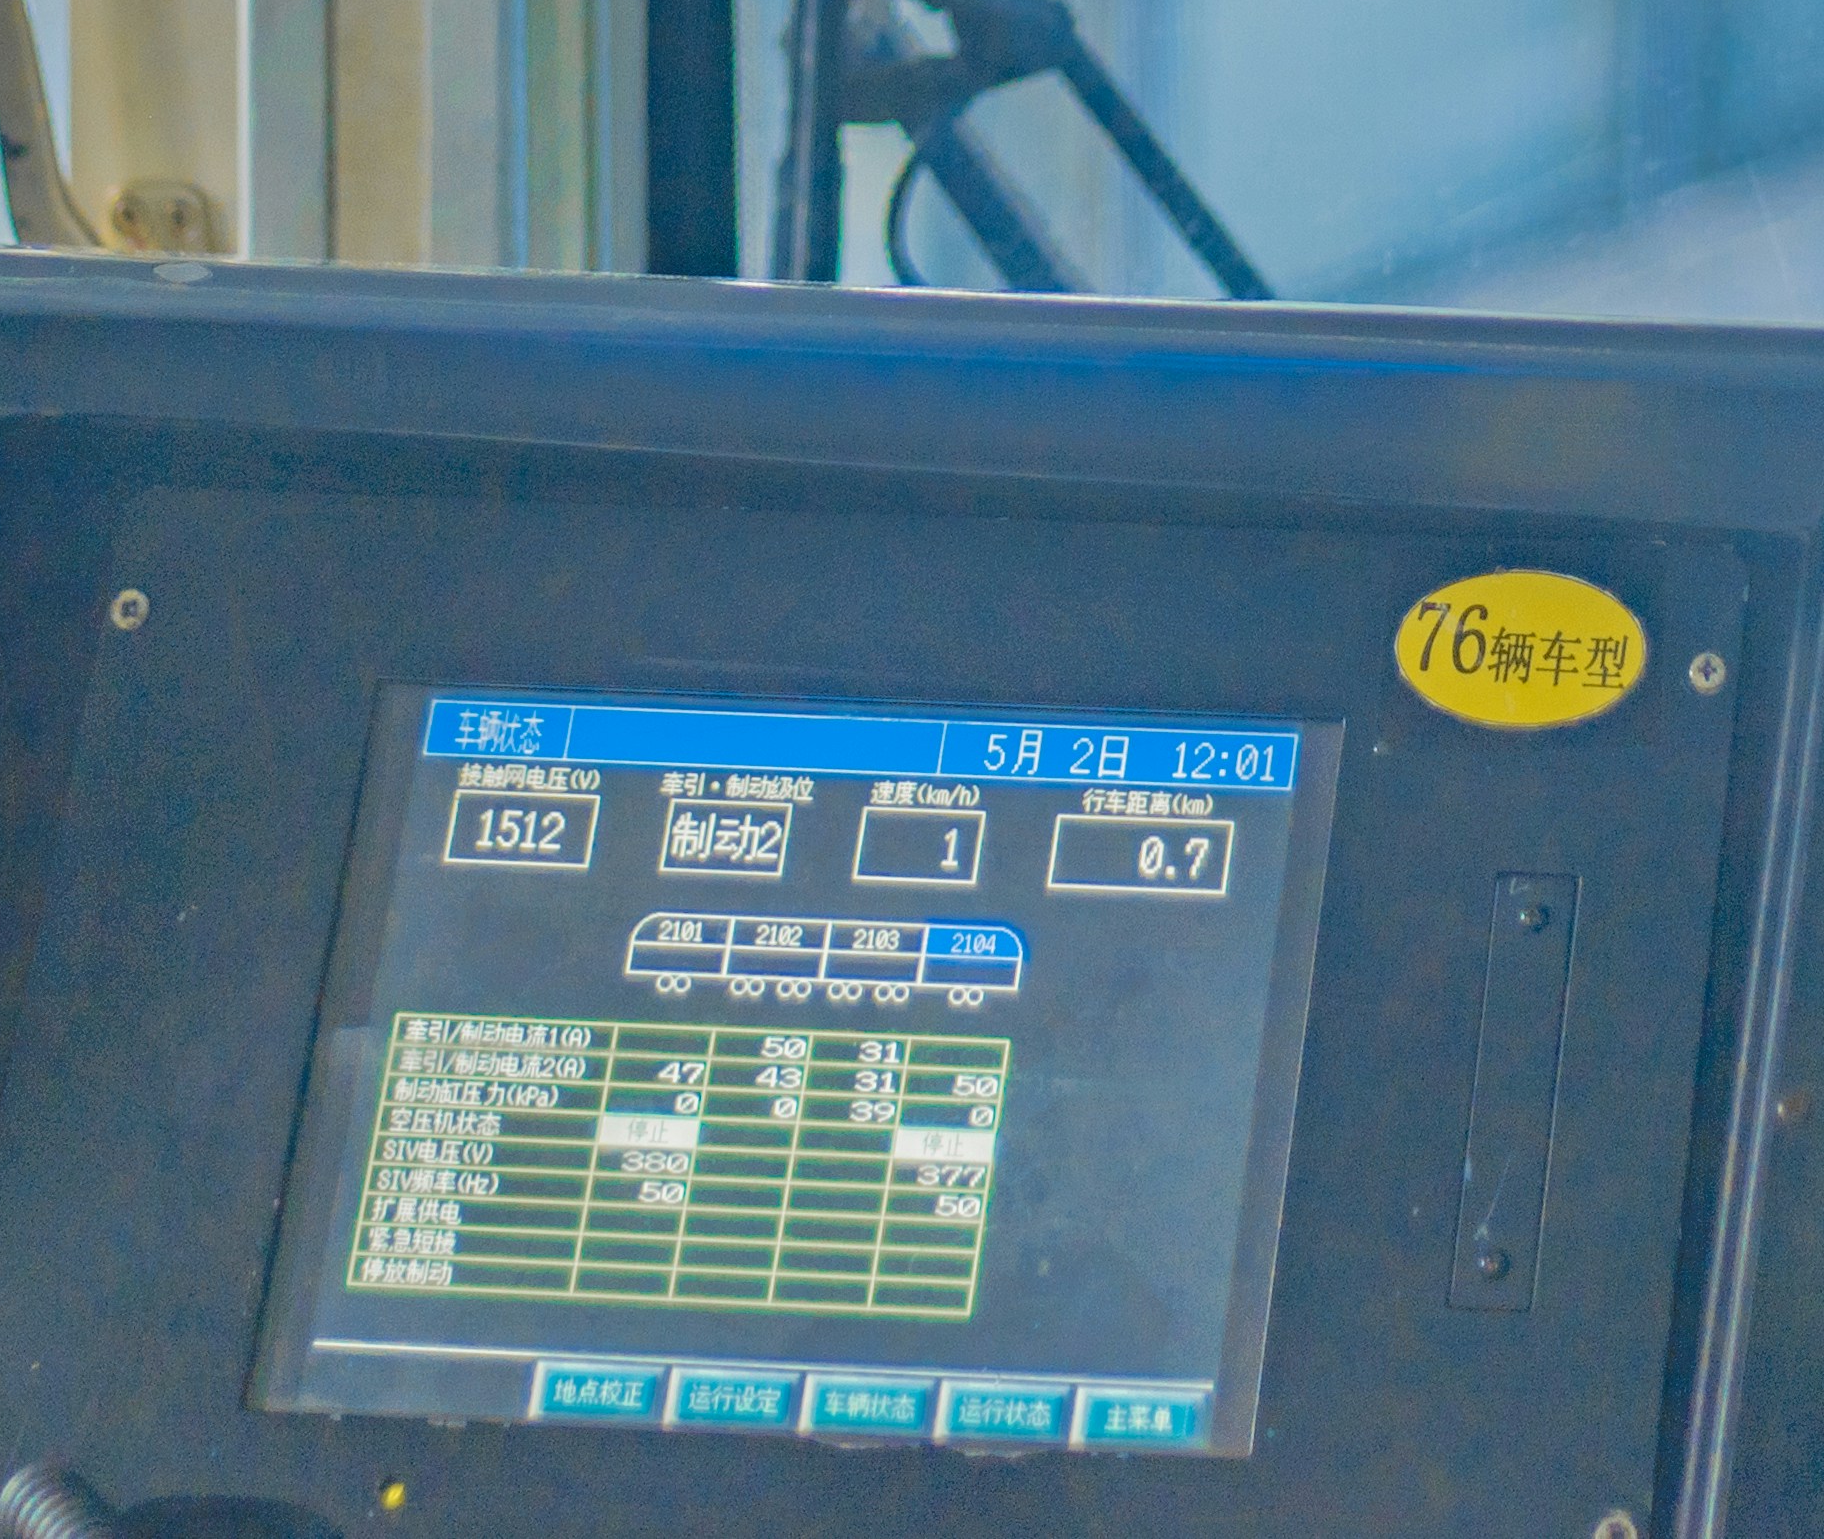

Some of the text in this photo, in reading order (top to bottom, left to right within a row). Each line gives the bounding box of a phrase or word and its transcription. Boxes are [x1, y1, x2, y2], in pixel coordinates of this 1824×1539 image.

[1417, 602, 1630, 690] 76辆车型
[454, 708, 545, 755] 车辆状态
[982, 728, 1276, 782] 5月 2日 12:01
[459, 762, 602, 791] 接触网电压(V)
[870, 780, 981, 807] 速度(km/h)
[1081, 788, 1213, 816] 行车距离(km)
[475, 808, 566, 852] 1512
[670, 812, 782, 861] 制动2
[939, 827, 960, 870] 1
[1137, 836, 1211, 881] 0.7
[657, 920, 704, 943] 2101
[755, 924, 803, 947] 2102
[852, 928, 900, 951] 2103
[950, 933, 997, 955] 2104
[760, 1037, 807, 1060] 50
[858, 1041, 900, 1064] 31
[657, 1062, 705, 1085] 47
[755, 1066, 802, 1089] 43
[854, 1071, 896, 1093] 31
[952, 1075, 999, 1097] 50
[675, 1092, 700, 1114] 0
[773, 1097, 798, 1119] 0
[849, 1101, 896, 1123] 39
[969, 1106, 994, 1127] 0
[388, 1109, 965, 1158] 空压机状态 停止 停止
[382, 1139, 986, 1188] SIV电压(V) 380 377
[376, 1168, 982, 1218] SIV频率(Hz) 50 50
[371, 1197, 462, 1225] 扩展供电
[361, 1257, 453, 1286] 停放制动
[553, 1378, 645, 1407] 地点校正
[687, 1383, 782, 1412] 运行设定
[824, 1390, 916, 1421] 车辆状态
[958, 1397, 1052, 1426] 运行状态
[1103, 1404, 1174, 1432] 主菜单
